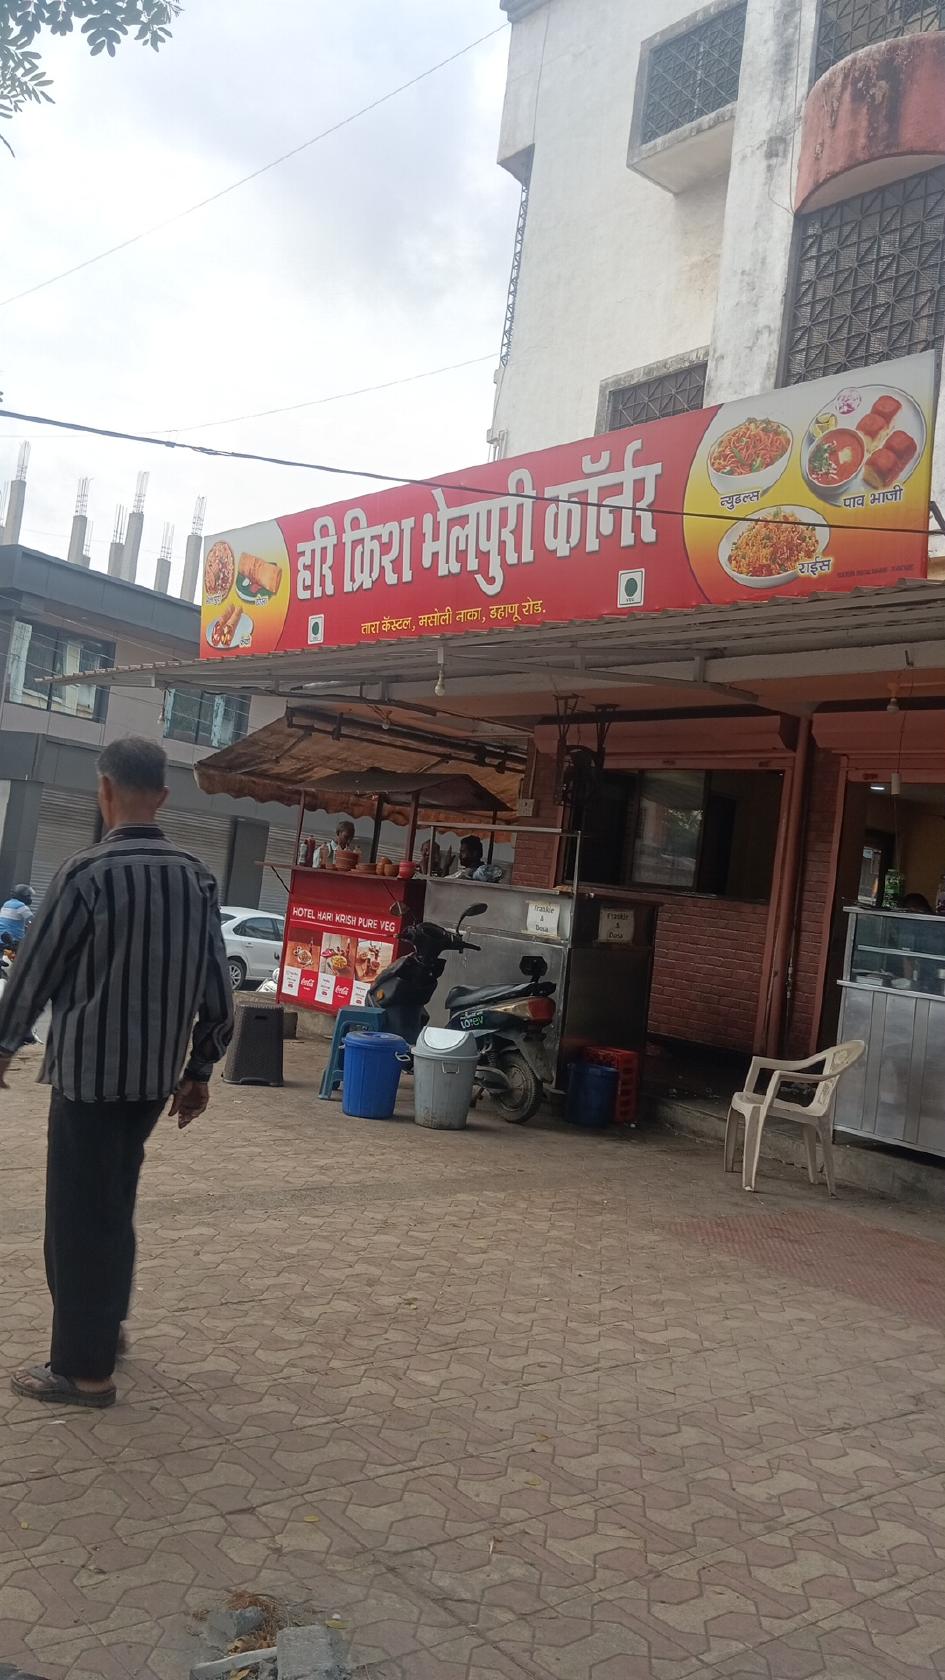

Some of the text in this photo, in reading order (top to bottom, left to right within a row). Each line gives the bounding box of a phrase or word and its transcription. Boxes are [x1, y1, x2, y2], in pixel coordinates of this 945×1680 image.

[842, 487, 904, 509] पाव भाजी
[297, 439, 663, 600] हरि क्रिश भेलपुरी कॉर्नर
[798, 556, 832, 575] राईस
[360, 621, 380, 635] तारा
[418, 606, 453, 627] मसोली
[456, 607, 486, 624] नाका,
[489, 603, 520, 622] डहाणू
[522, 596, 547, 615] रोड.
[293, 907, 395, 932] HOTEL HARI KRISH PURE VEG
[535, 924, 549, 933] Dosa
